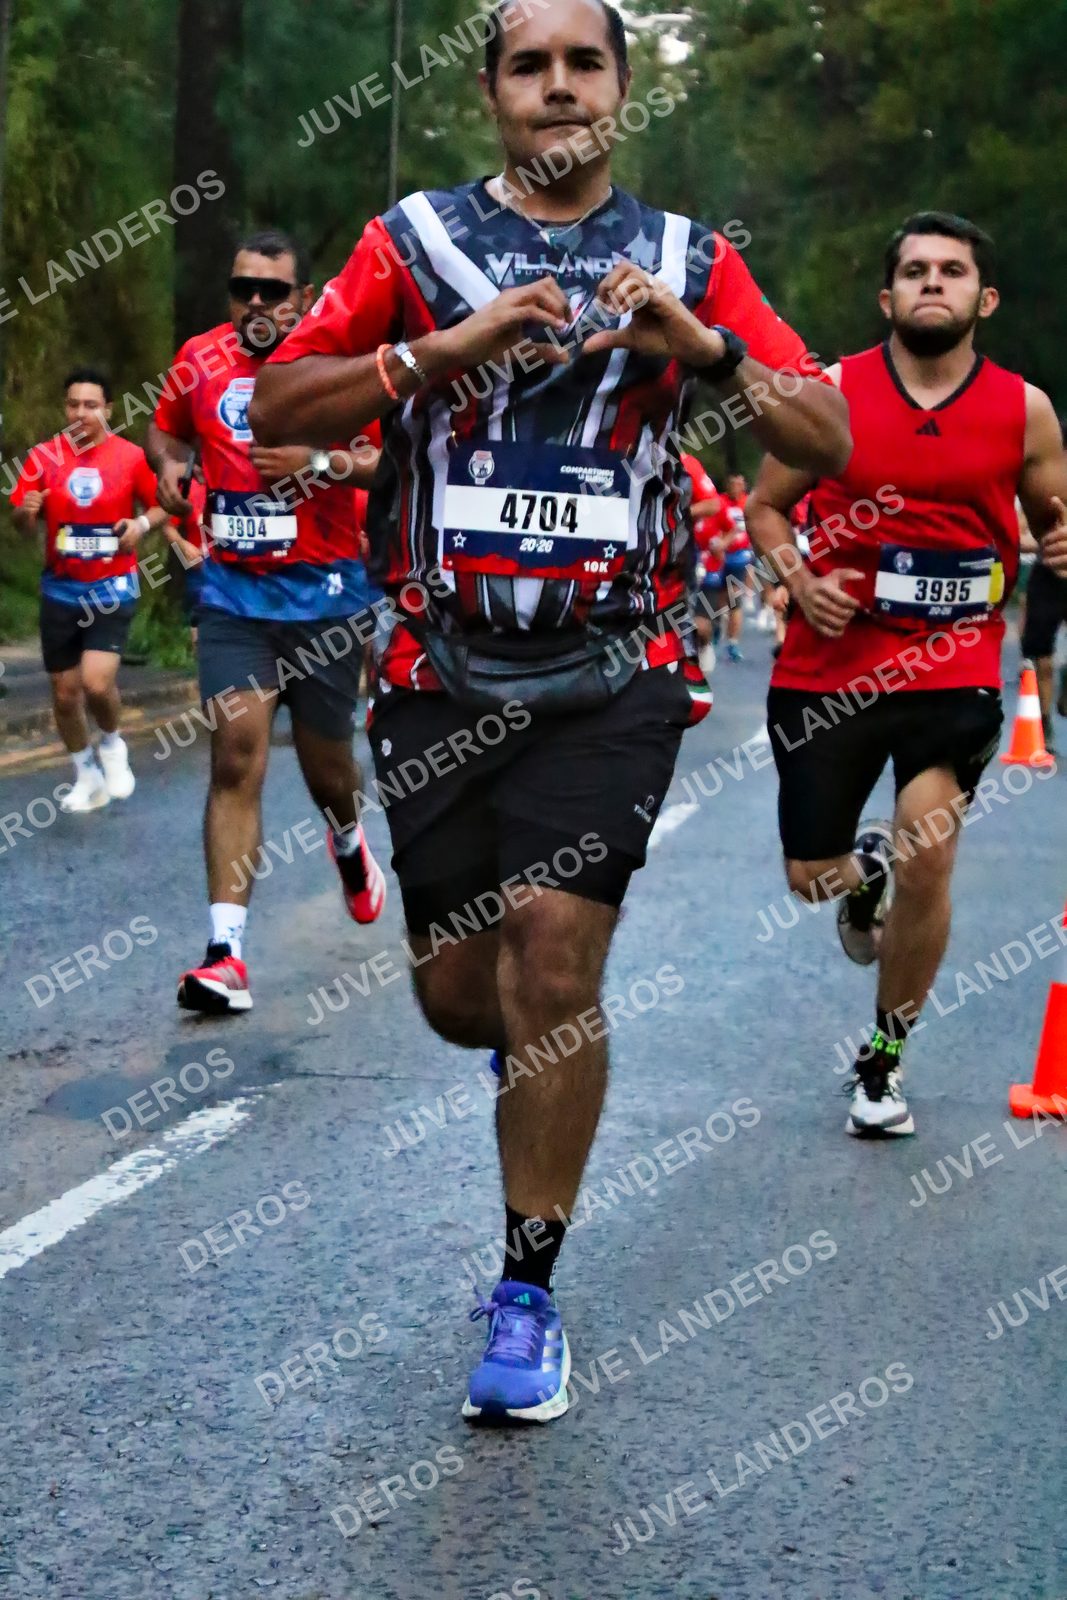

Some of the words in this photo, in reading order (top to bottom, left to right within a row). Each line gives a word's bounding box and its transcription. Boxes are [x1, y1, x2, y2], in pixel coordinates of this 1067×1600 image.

[499, 492, 579, 533] 4704
[583, 560, 609, 573] 10K
[915, 578, 972, 602] 3935
